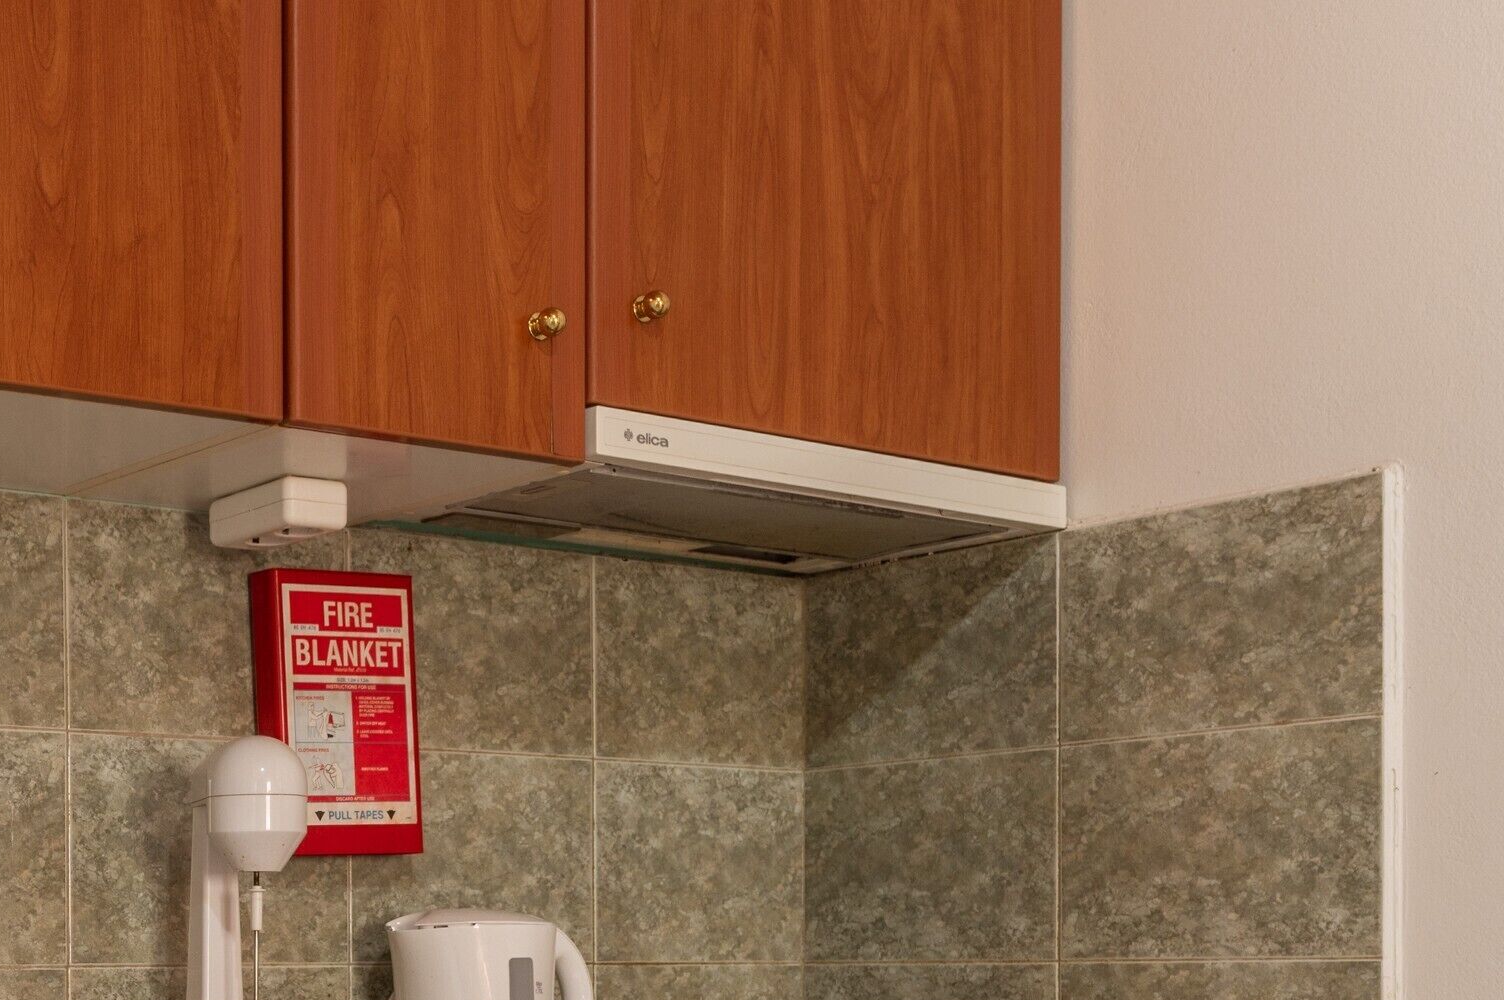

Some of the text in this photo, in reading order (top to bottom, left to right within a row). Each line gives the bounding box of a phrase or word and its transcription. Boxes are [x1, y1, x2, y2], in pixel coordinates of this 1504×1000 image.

[636, 432, 669, 448] elica
[323, 601, 374, 628] FIRE
[296, 639, 401, 667] BLANKET
[328, 810, 384, 820] PULL TAPES
